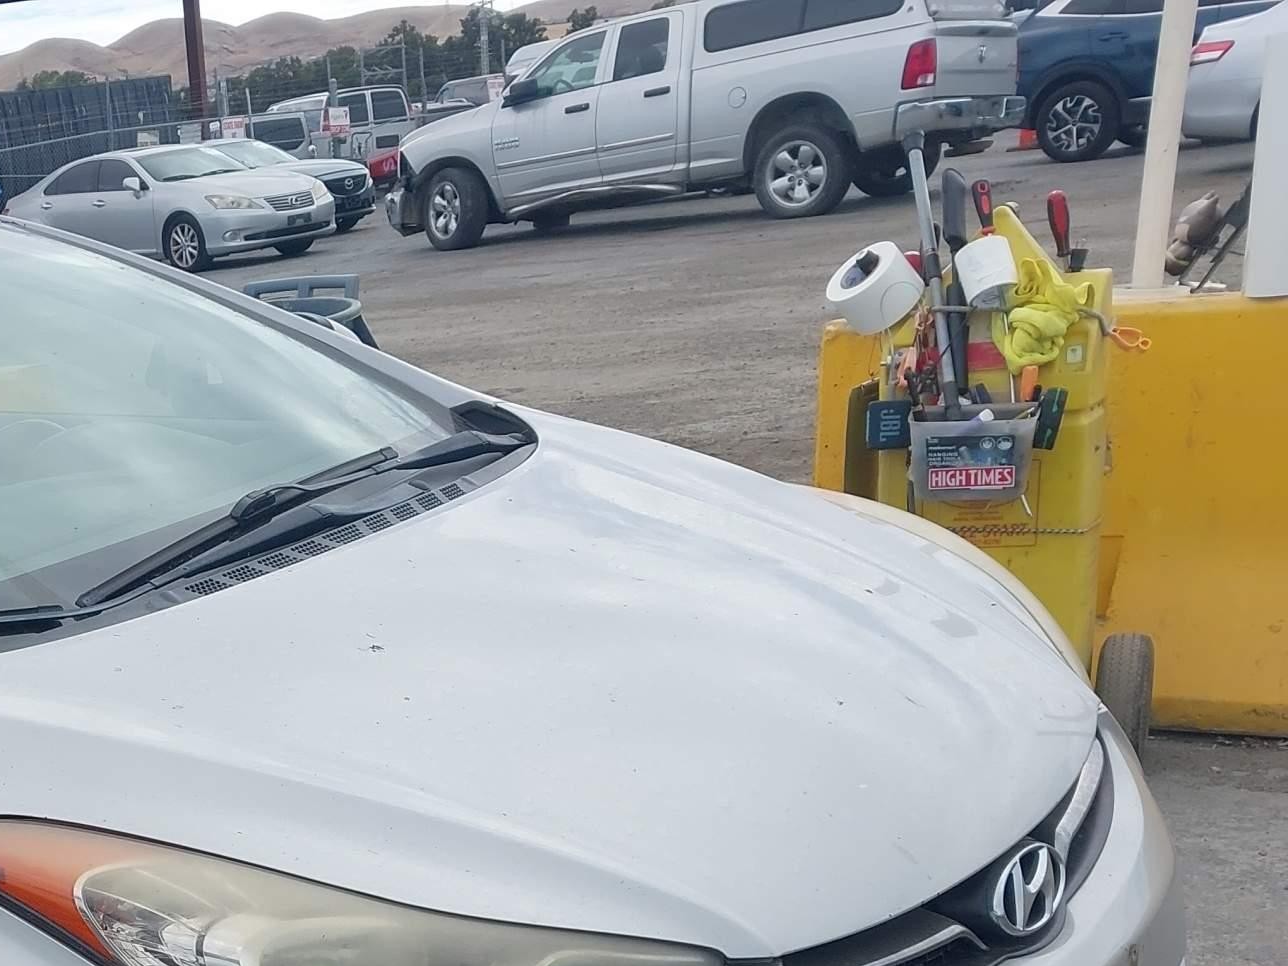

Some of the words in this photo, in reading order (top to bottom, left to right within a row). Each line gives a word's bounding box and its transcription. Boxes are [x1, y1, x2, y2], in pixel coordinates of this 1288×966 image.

[880, 409, 901, 442] JBL
[932, 471, 966, 487] HIGH
[968, 469, 1012, 486] TIMES
